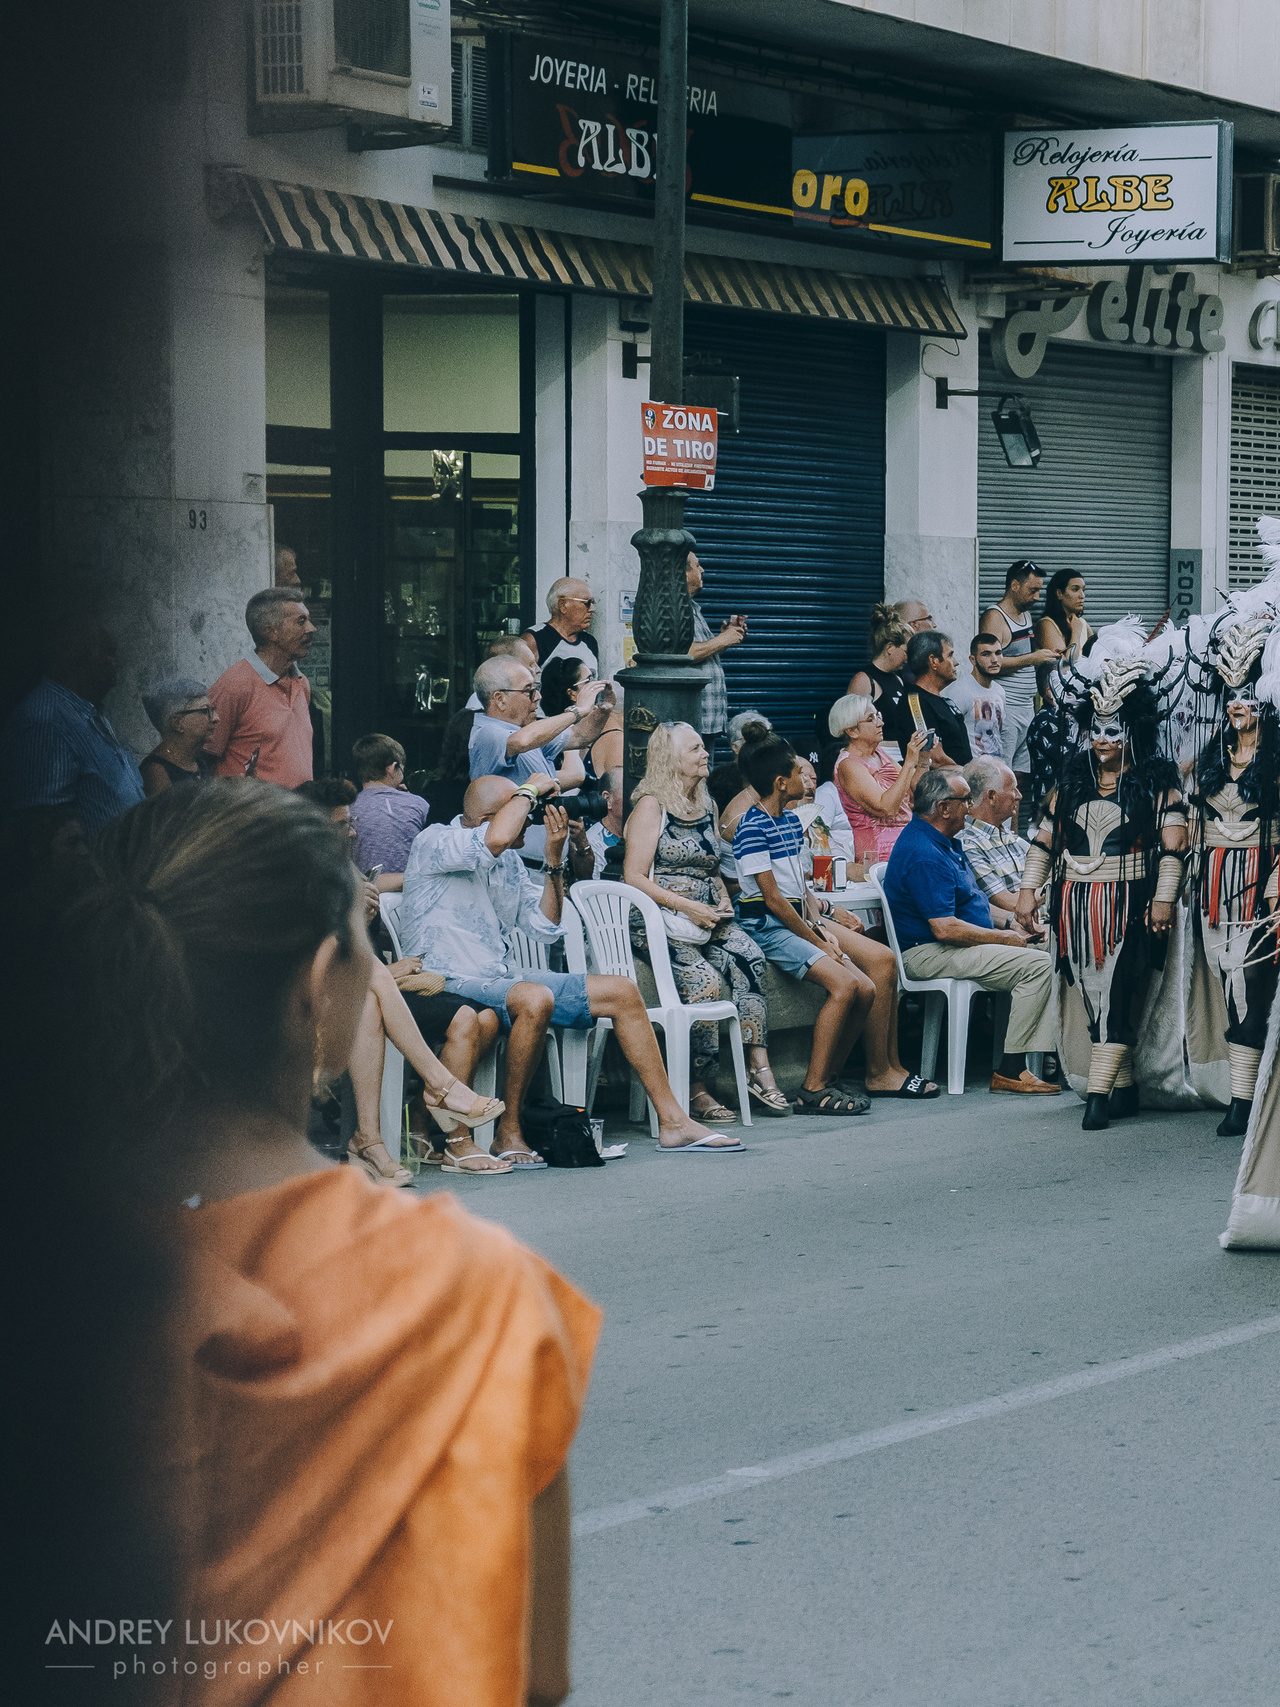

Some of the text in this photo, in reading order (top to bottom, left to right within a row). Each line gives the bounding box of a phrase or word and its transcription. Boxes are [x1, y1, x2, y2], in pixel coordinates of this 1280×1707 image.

[529, 54, 607, 95] JOYERIA
[625, 73, 718, 117] RELRIA
[577, 118, 658, 180] ALB
[1012, 137, 1140, 176] Relojería
[792, 169, 869, 216] oro
[1046, 174, 1174, 213] ALBE
[1087, 213, 1208, 255] Joyería
[662, 409, 714, 432] ZONA
[644, 436, 715, 461] DE TIRO
[188, 509, 207, 530] 93
